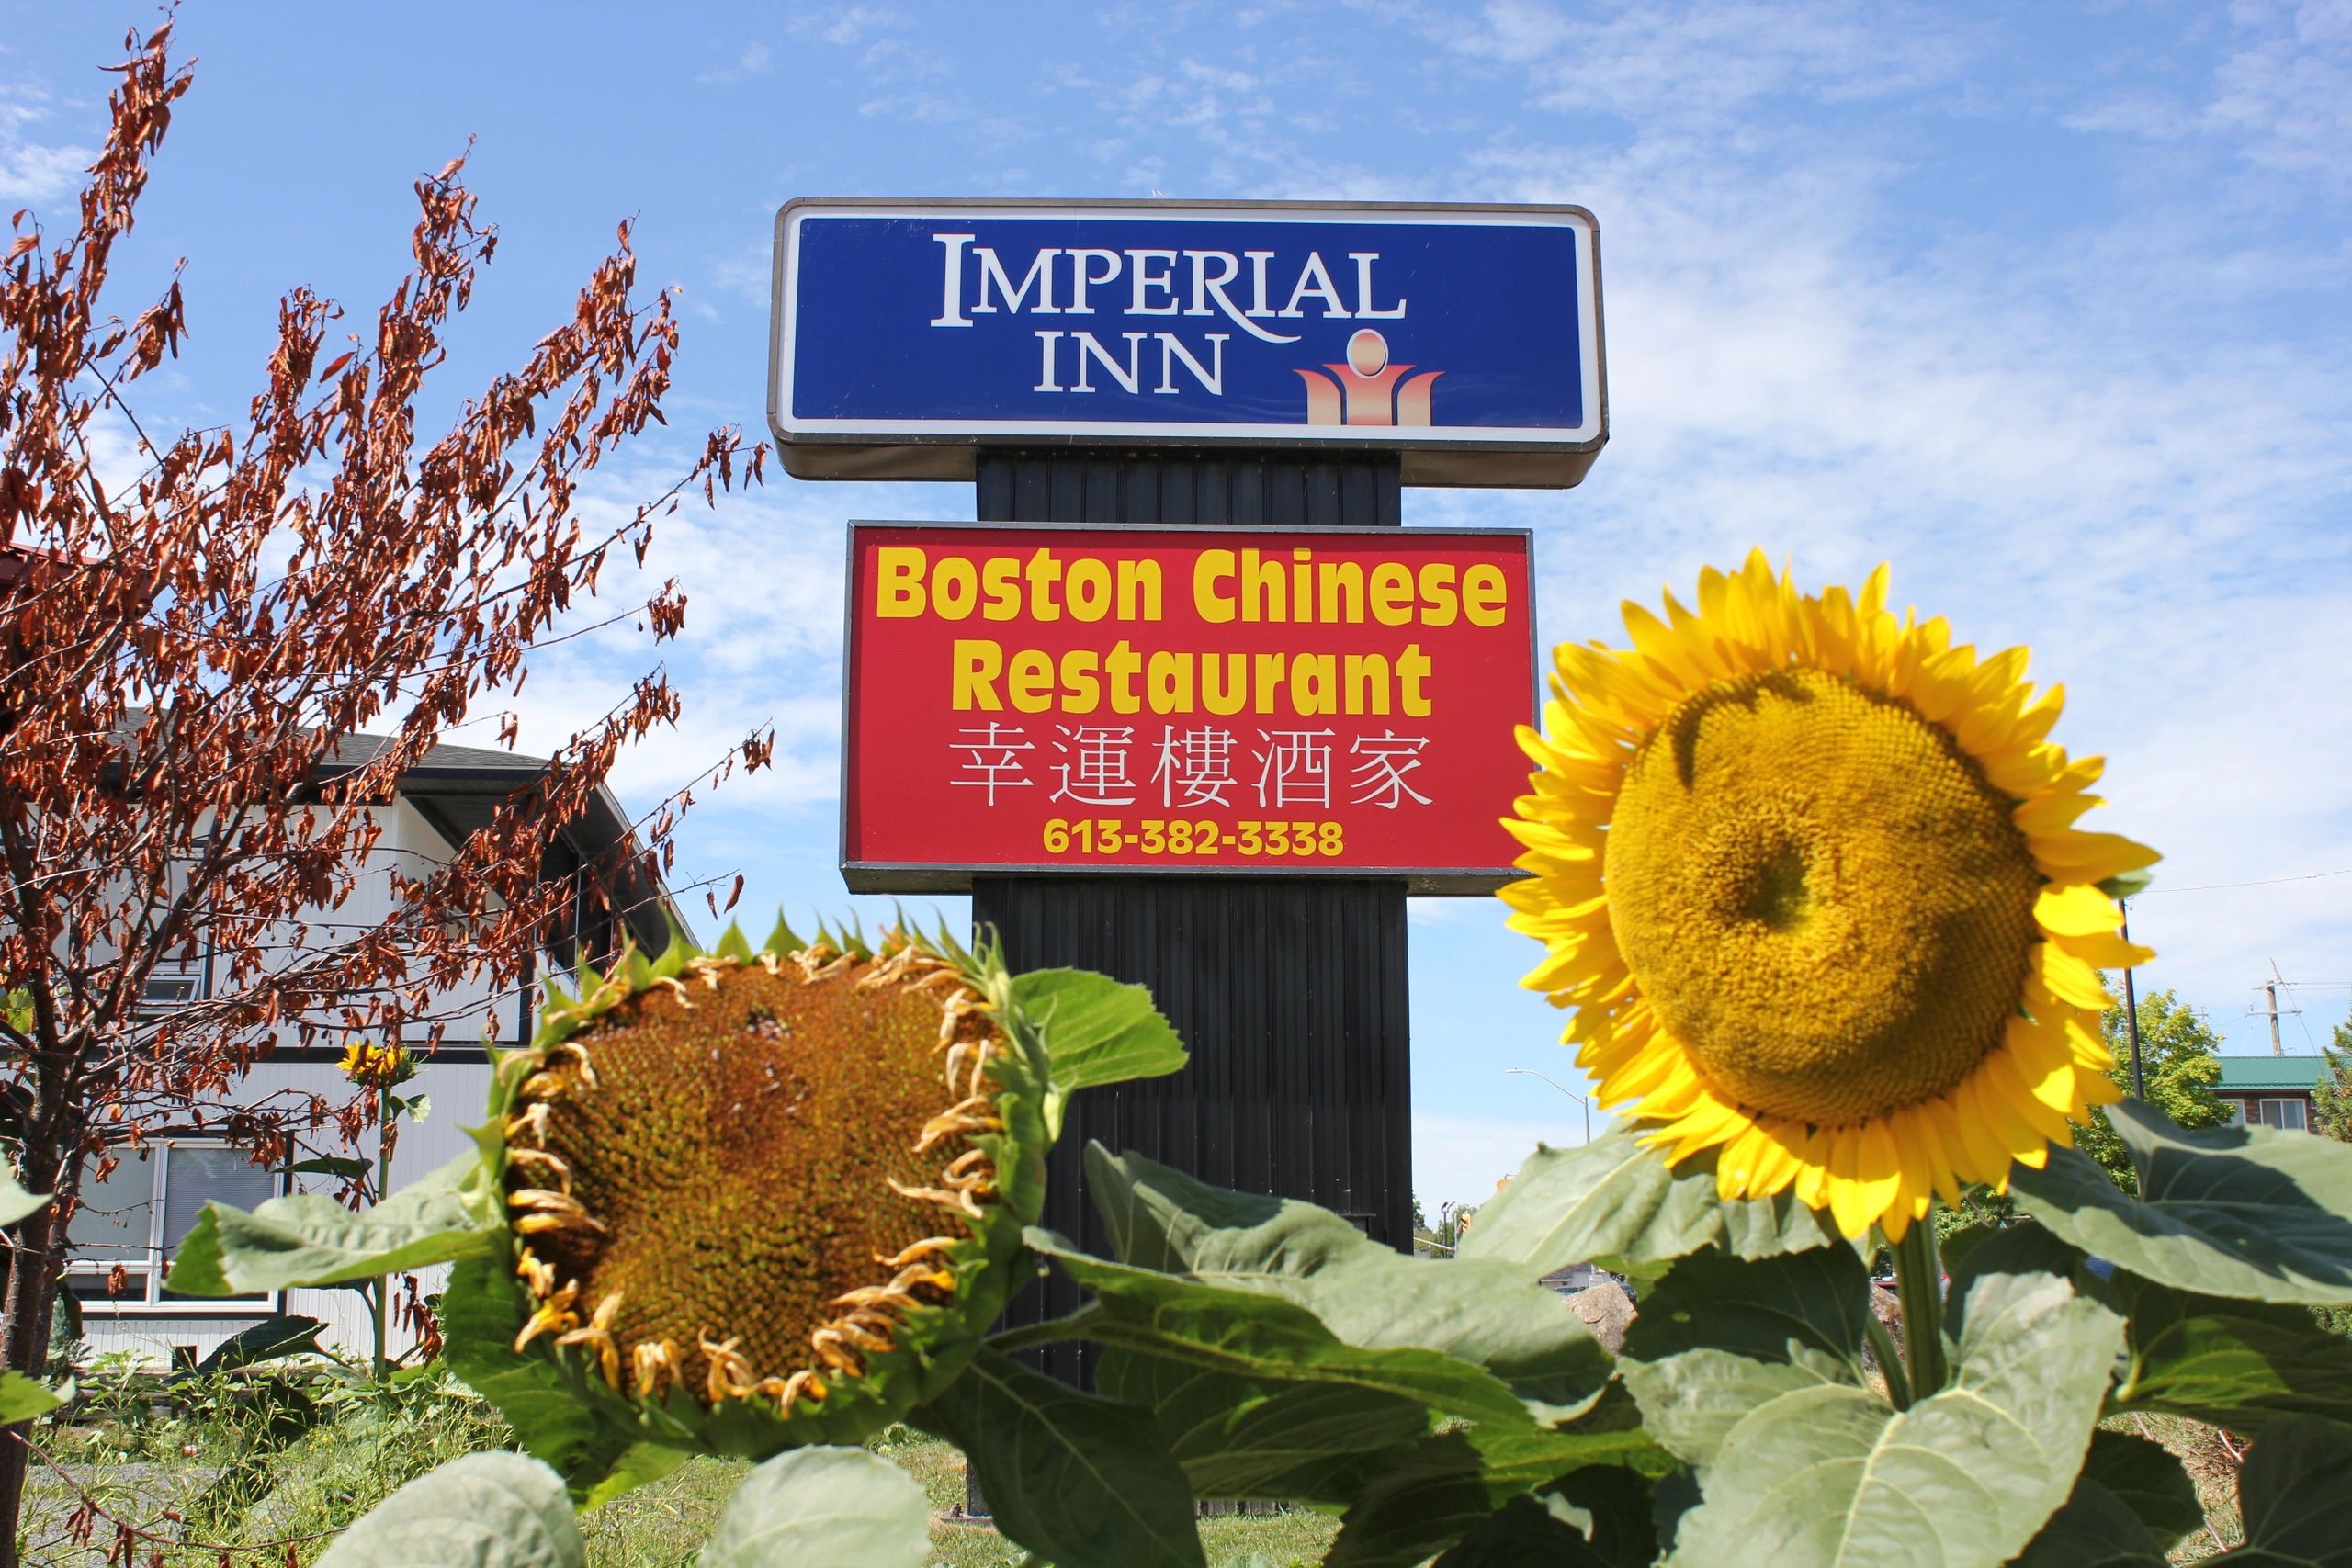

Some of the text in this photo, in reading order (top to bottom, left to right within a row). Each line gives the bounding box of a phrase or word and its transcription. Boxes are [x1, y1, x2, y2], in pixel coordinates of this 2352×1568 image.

[930, 233, 1407, 344] IMPERIAL
[1033, 330, 1230, 396] INN
[876, 547, 1508, 627] Boston Chinese
[952, 639, 1432, 717] Restaurant
[949, 721, 1433, 810] 幸運樓酒家
[1043, 818, 1344, 856] 613-382-3338
